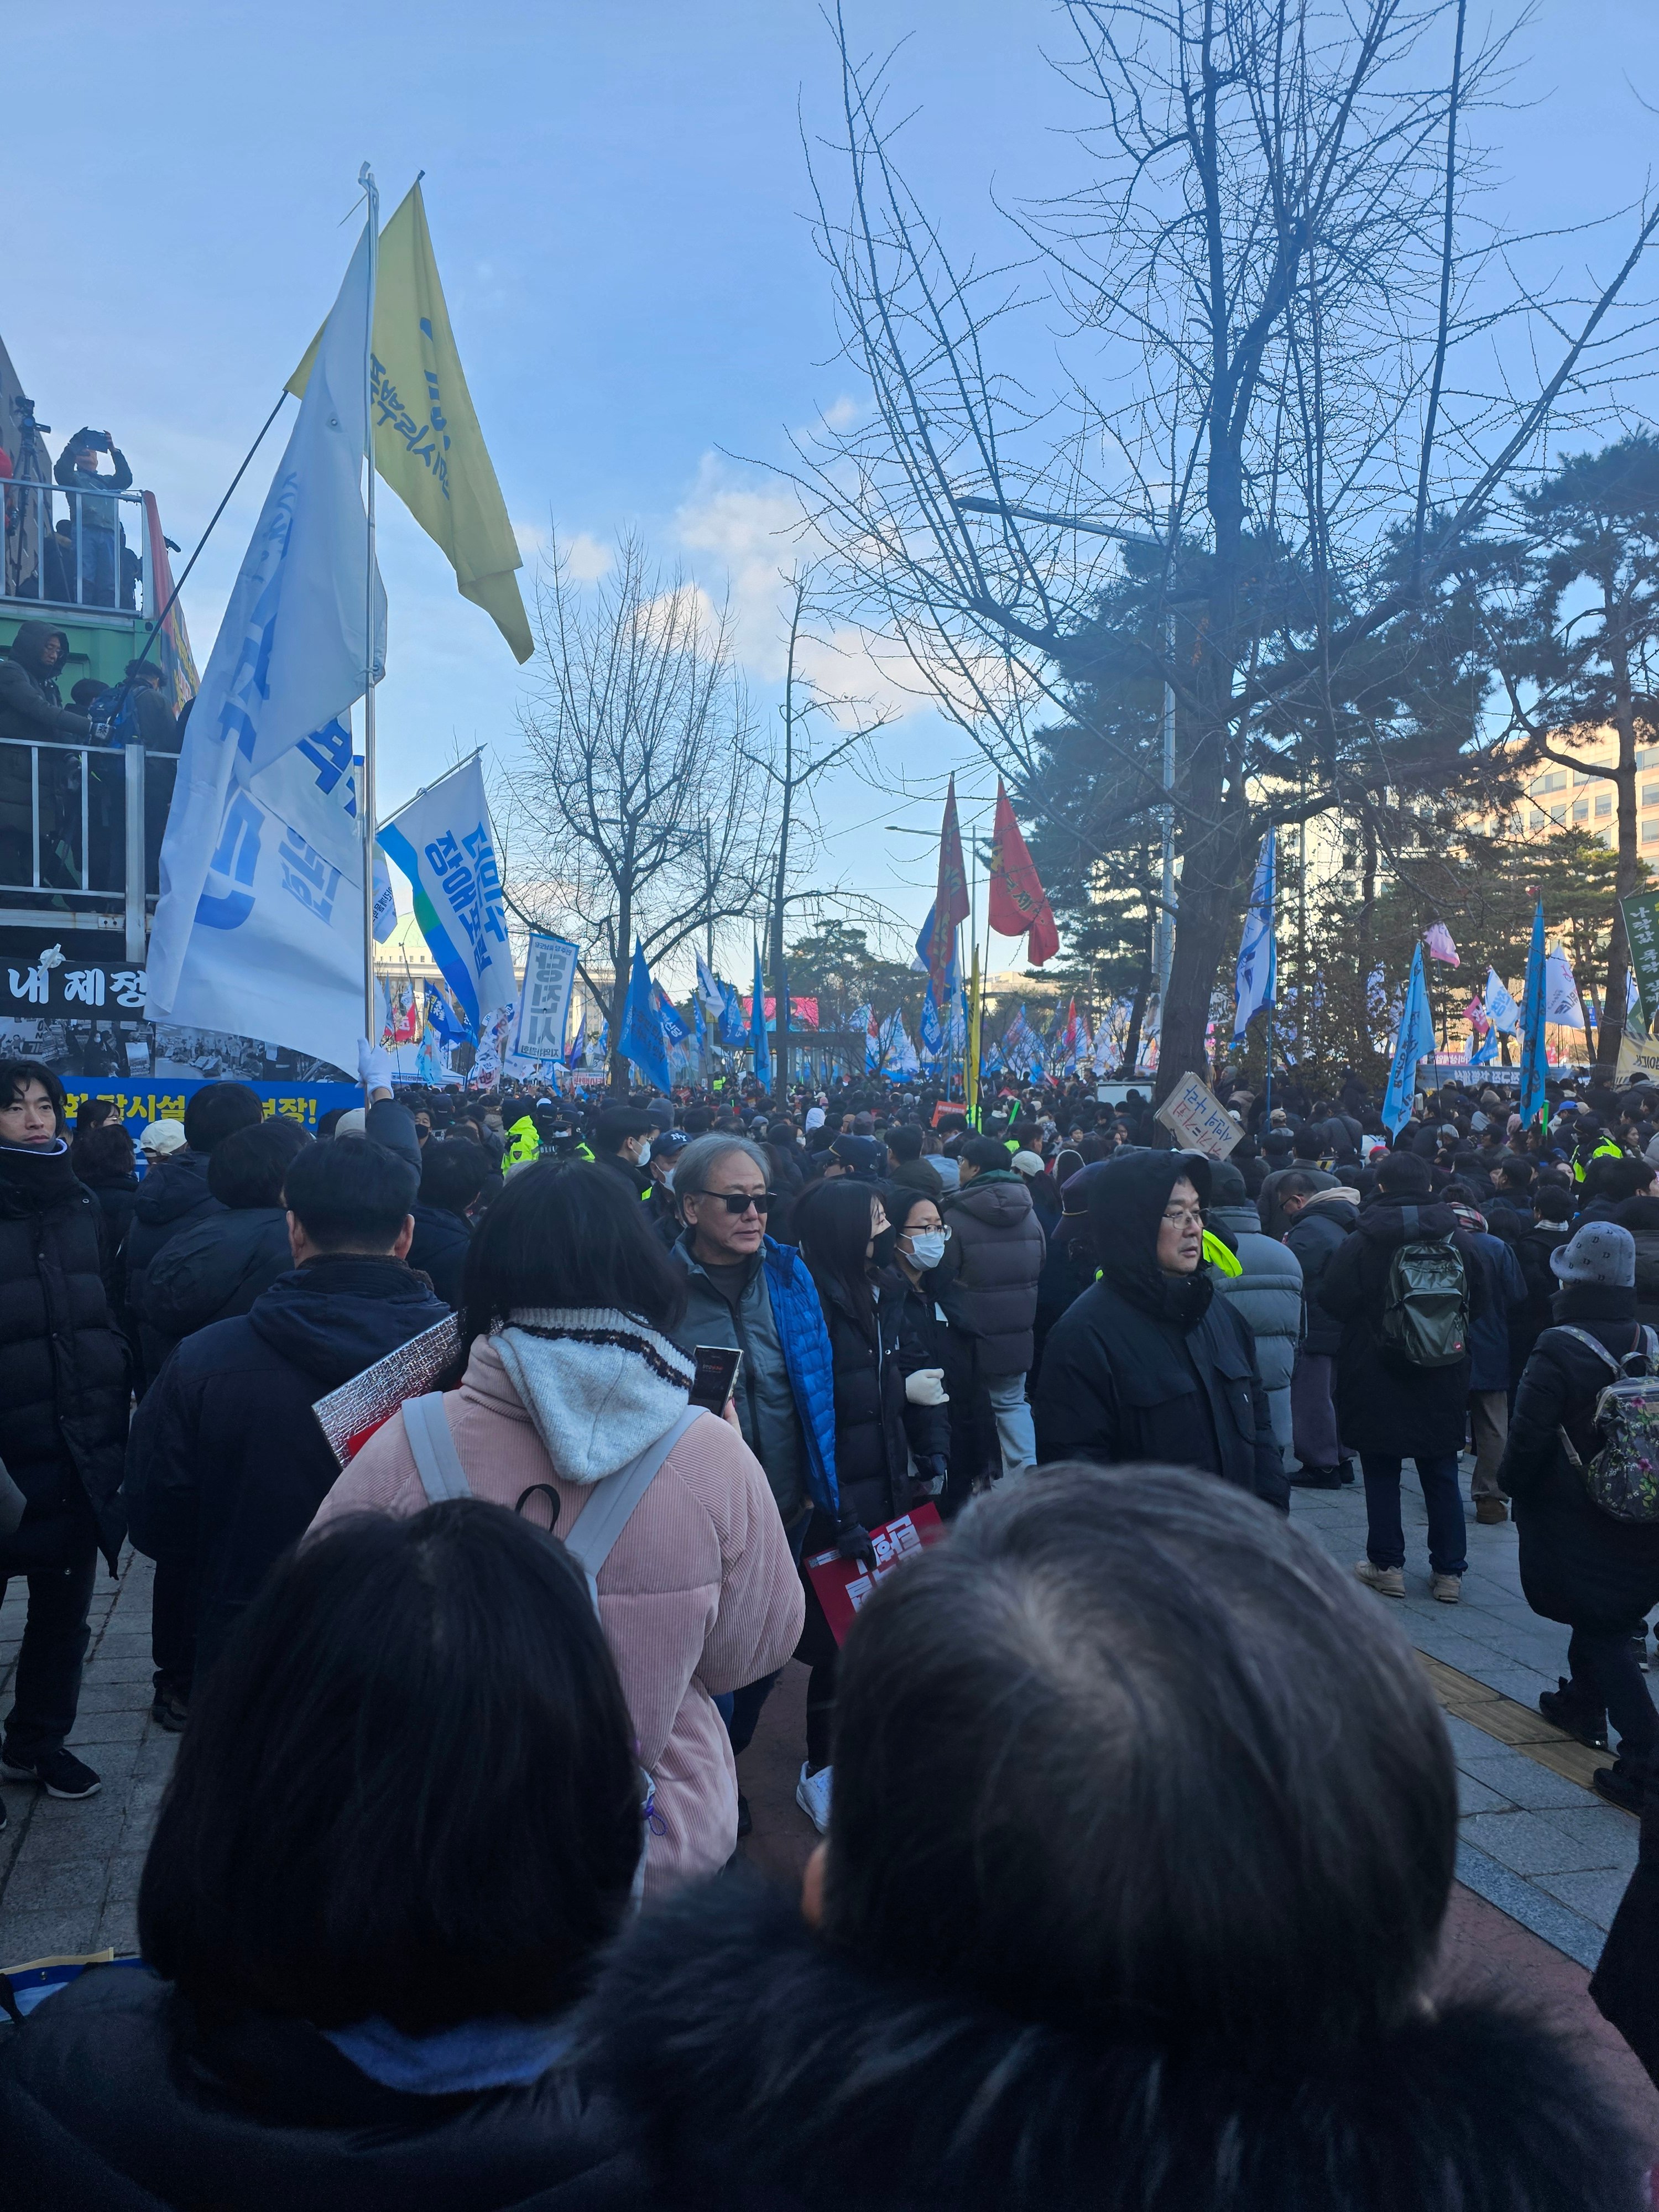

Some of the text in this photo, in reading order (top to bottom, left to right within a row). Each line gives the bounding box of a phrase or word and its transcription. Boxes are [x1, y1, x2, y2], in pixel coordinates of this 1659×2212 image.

[461, 822, 508, 943] 더민주
[1183, 1085, 1232, 1141] 시민의 나라
